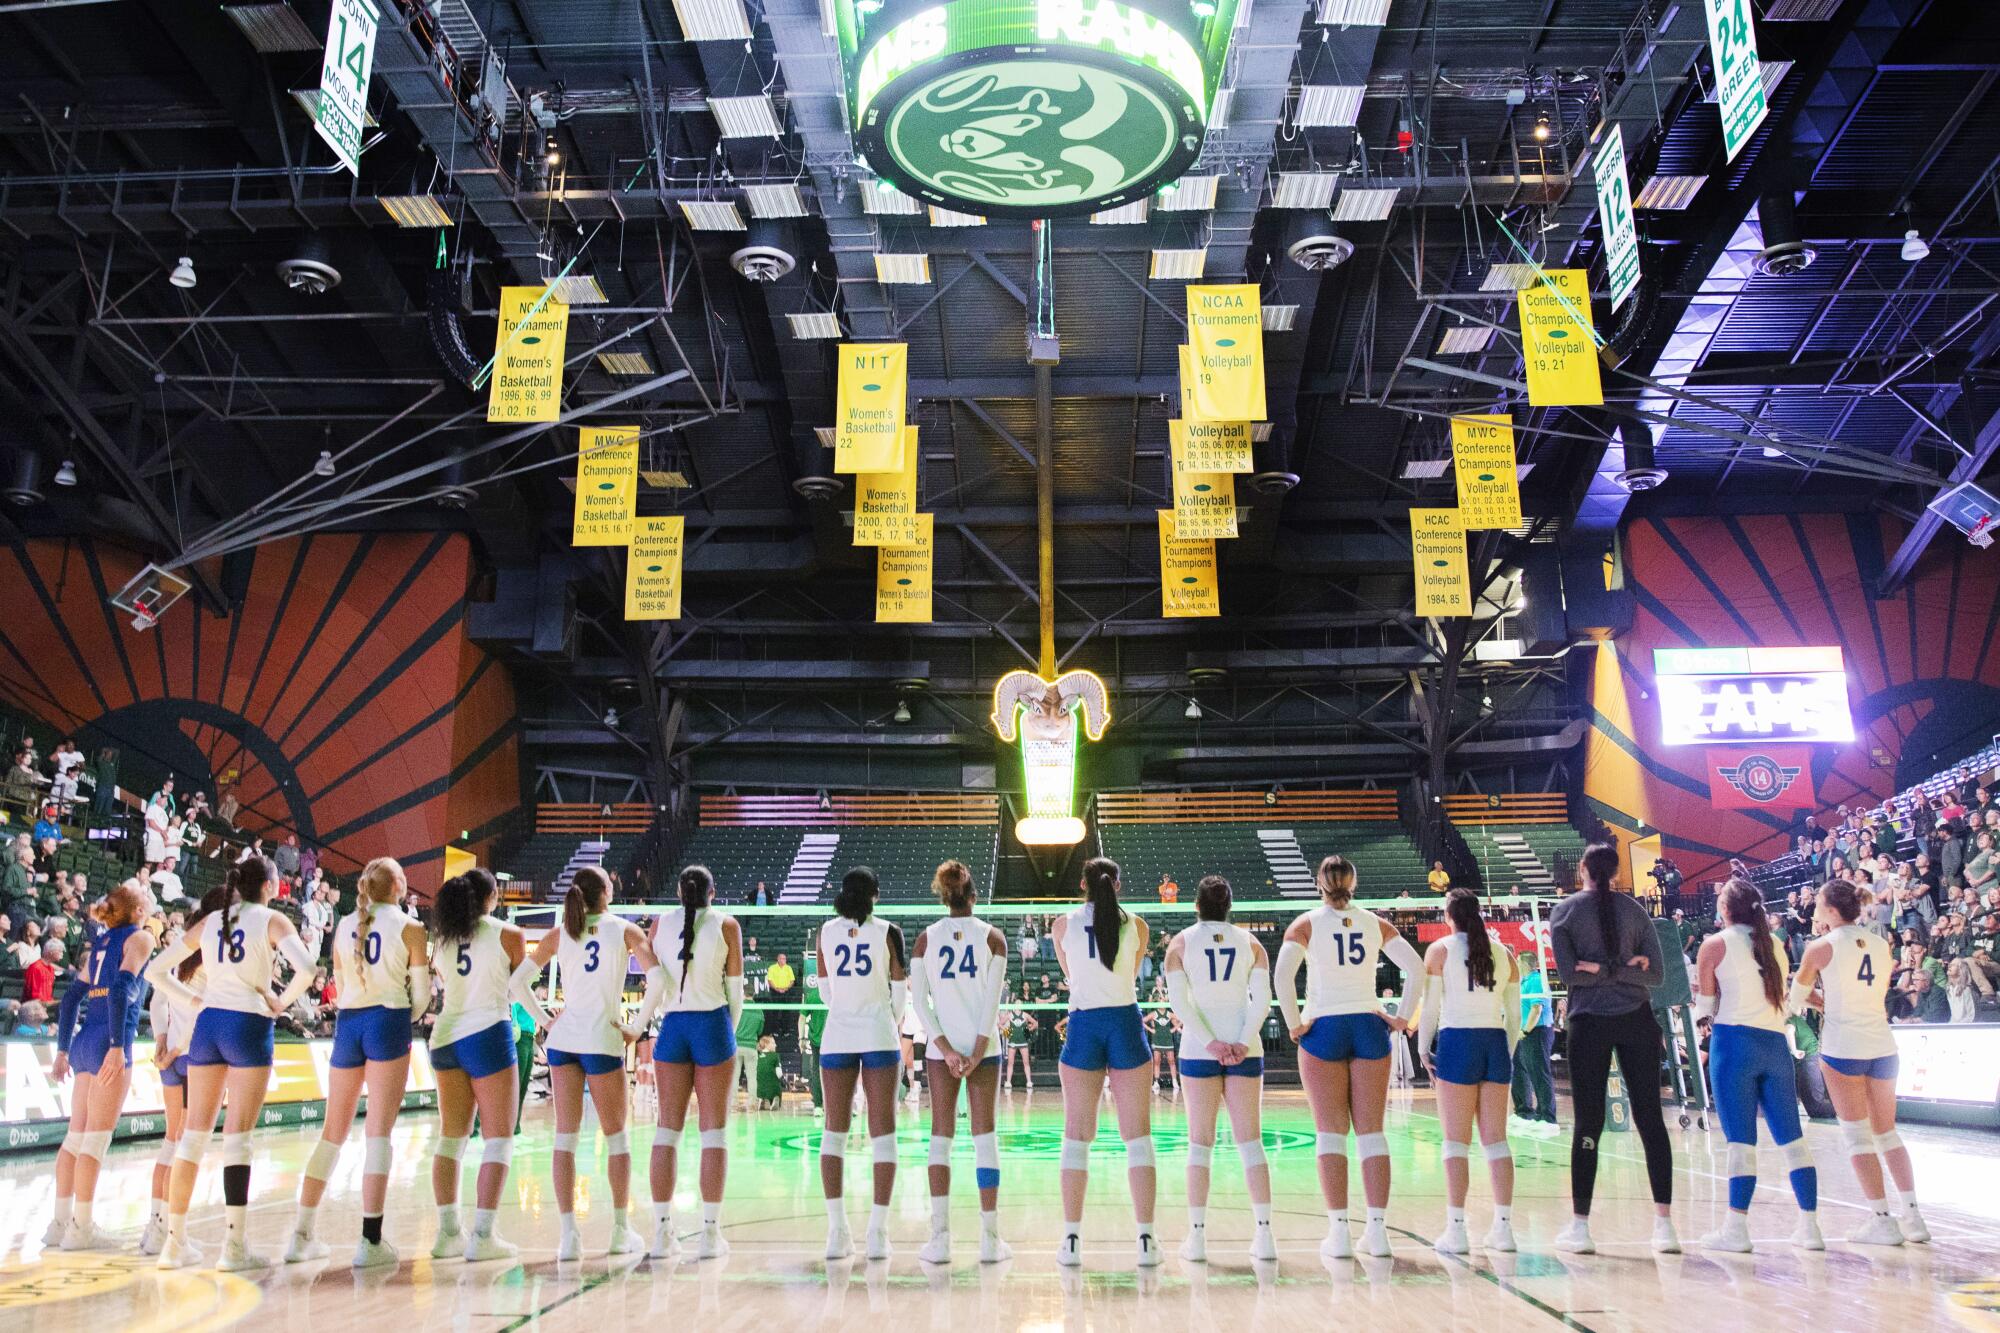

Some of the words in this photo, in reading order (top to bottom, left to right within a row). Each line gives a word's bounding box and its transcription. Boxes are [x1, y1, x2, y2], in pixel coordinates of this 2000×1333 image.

[1718, 0, 1747, 76] 24
[339, 13, 366, 94] 14
[1722, 50, 1758, 106] GREEN
[325, 64, 365, 122] MOSLEY
[321, 93, 360, 148] FOOTBALL
[1597, 145, 1622, 193] SHERRI
[1604, 177, 1626, 237] 12
[1203, 295, 1244, 308] NCAA
[1191, 313, 1258, 326] Tournament
[1535, 341, 1585, 357] Volleyball
[507, 356, 552, 368] Women's
[1201, 354, 1252, 370] Volleyball
[1553, 359, 1565, 370] 21
[500, 375, 552, 387] Basketball
[1200, 373, 1212, 384] 19
[541, 390, 552, 400] 99
[526, 405, 537, 416] 16
[849, 408, 893, 419] Women's
[845, 422, 896, 434] Basketball
[1189, 425, 1244, 440] Volleyball
[1467, 427, 1497, 438] MWC
[840, 438, 852, 449] 22
[1456, 443, 1511, 454] Conference
[585, 450, 632, 460] Conference
[1459, 458, 1511, 471] Champions
[584, 465, 633, 477] Champions
[866, 489, 906, 500] Women's
[1466, 482, 1509, 496] Volleyball
[586, 495, 624, 505] Women's
[1180, 494, 1230, 507] Volleyball
[862, 502, 908, 513] Basketball
[583, 510, 627, 520] Basketball
[1425, 515, 1450, 525] HCAC
[625, 523, 632, 533] 17
[648, 522, 666, 532] WAC
[634, 535, 678, 545] Conference
[1415, 529, 1463, 540] Conference
[634, 548, 678, 558] Champions
[882, 548, 929, 558] Tournament
[1164, 545, 1213, 556] Tournament
[1416, 543, 1463, 556] Champions
[882, 561, 928, 574] Champions
[1166, 558, 1212, 571] Champions
[637, 576, 670, 586] Women's
[1422, 575, 1461, 588] Volleyball
[635, 589, 673, 599] Basketball
[880, 588, 901, 599] Women's
[904, 589, 929, 599] Basketball
[1171, 587, 1210, 600] Volleyball
[1450, 594, 1460, 604] 85
[639, 601, 666, 611] 1995-96
[1753, 771, 1767, 785] 14
[821, 798, 830, 808] A
[1266, 793, 1276, 804] S
[1489, 796, 1499, 807] S
[602, 804, 612, 816] A
[1334, 932, 1365, 966] 15
[456, 944, 472, 976] 5
[584, 940, 600, 972] 3
[835, 943, 872, 977] 25
[938, 944, 977, 979] 24
[1204, 947, 1236, 982] 17
[1857, 954, 1875, 987] 4
